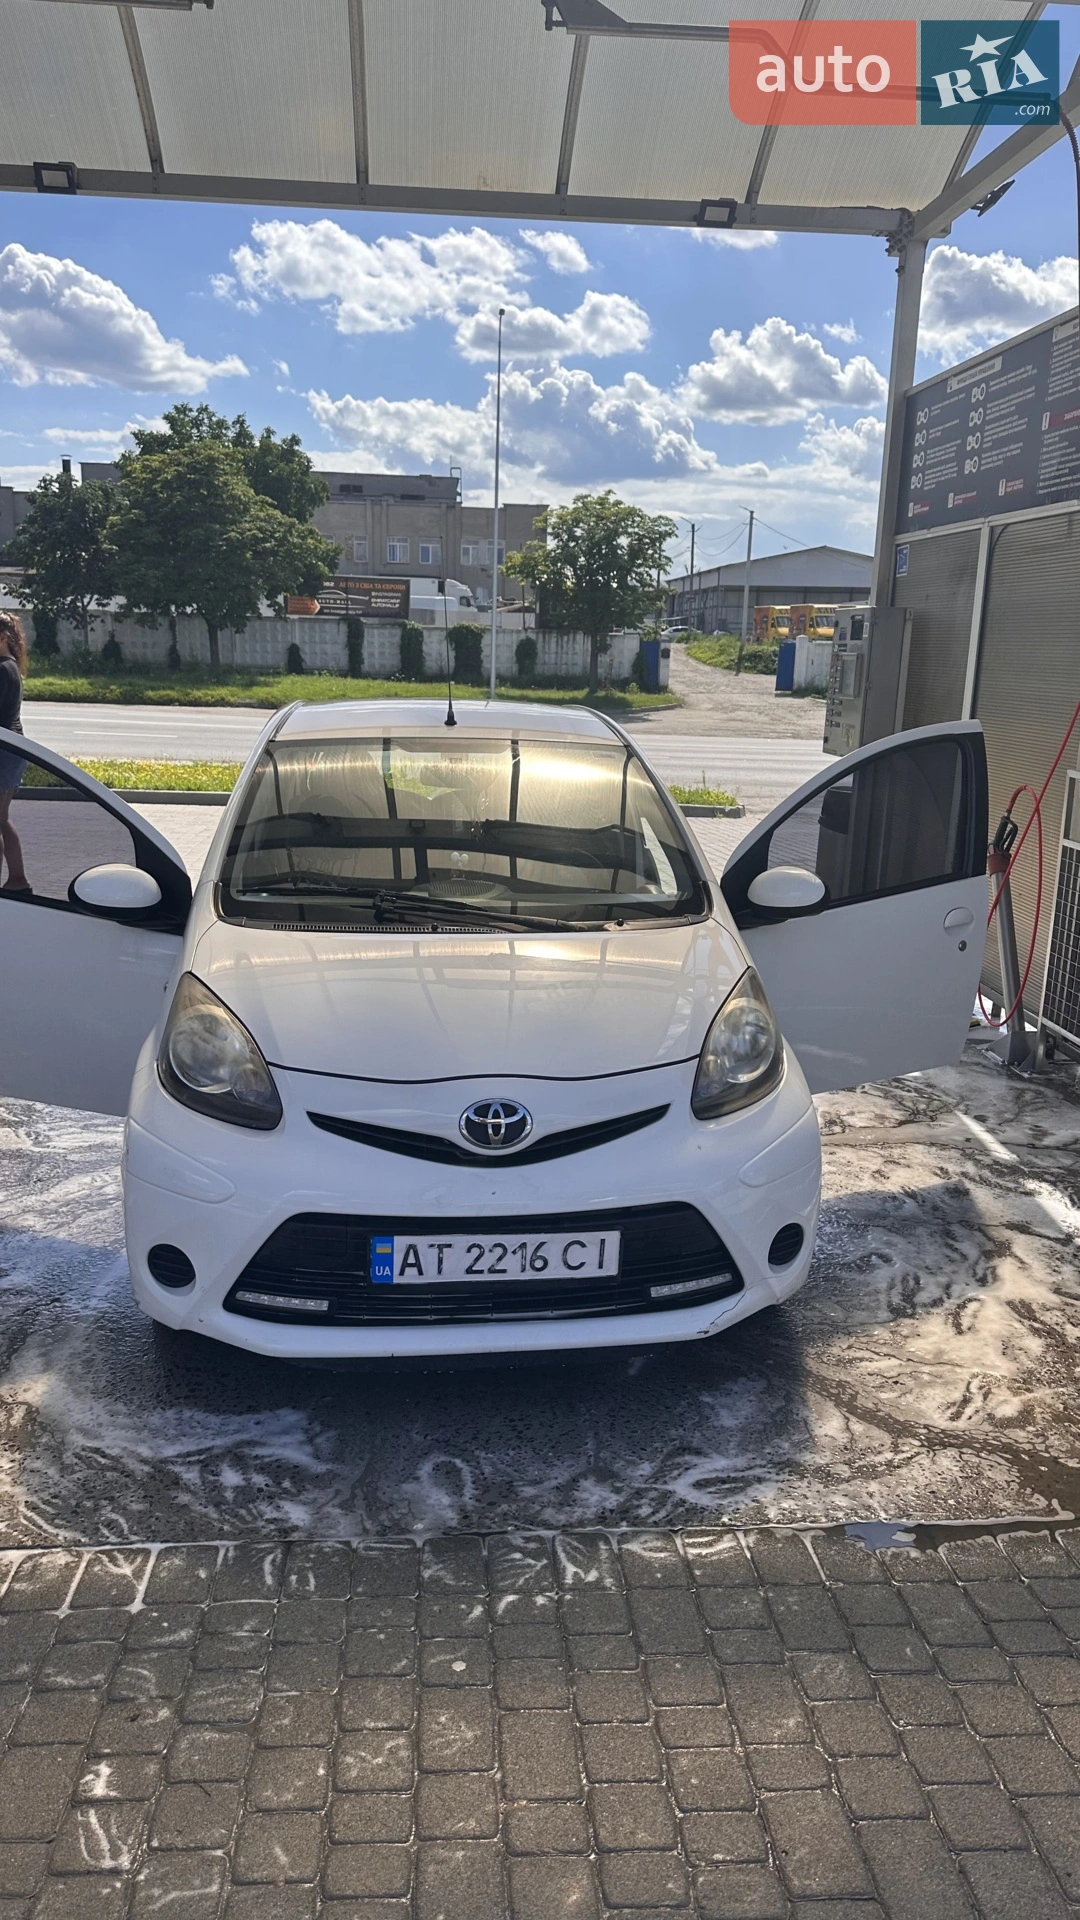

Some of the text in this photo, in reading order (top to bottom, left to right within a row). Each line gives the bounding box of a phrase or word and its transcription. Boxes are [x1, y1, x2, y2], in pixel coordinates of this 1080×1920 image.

[399, 1238, 606, 1276] AT 2216 CI
[375, 1265, 392, 1277] UA
